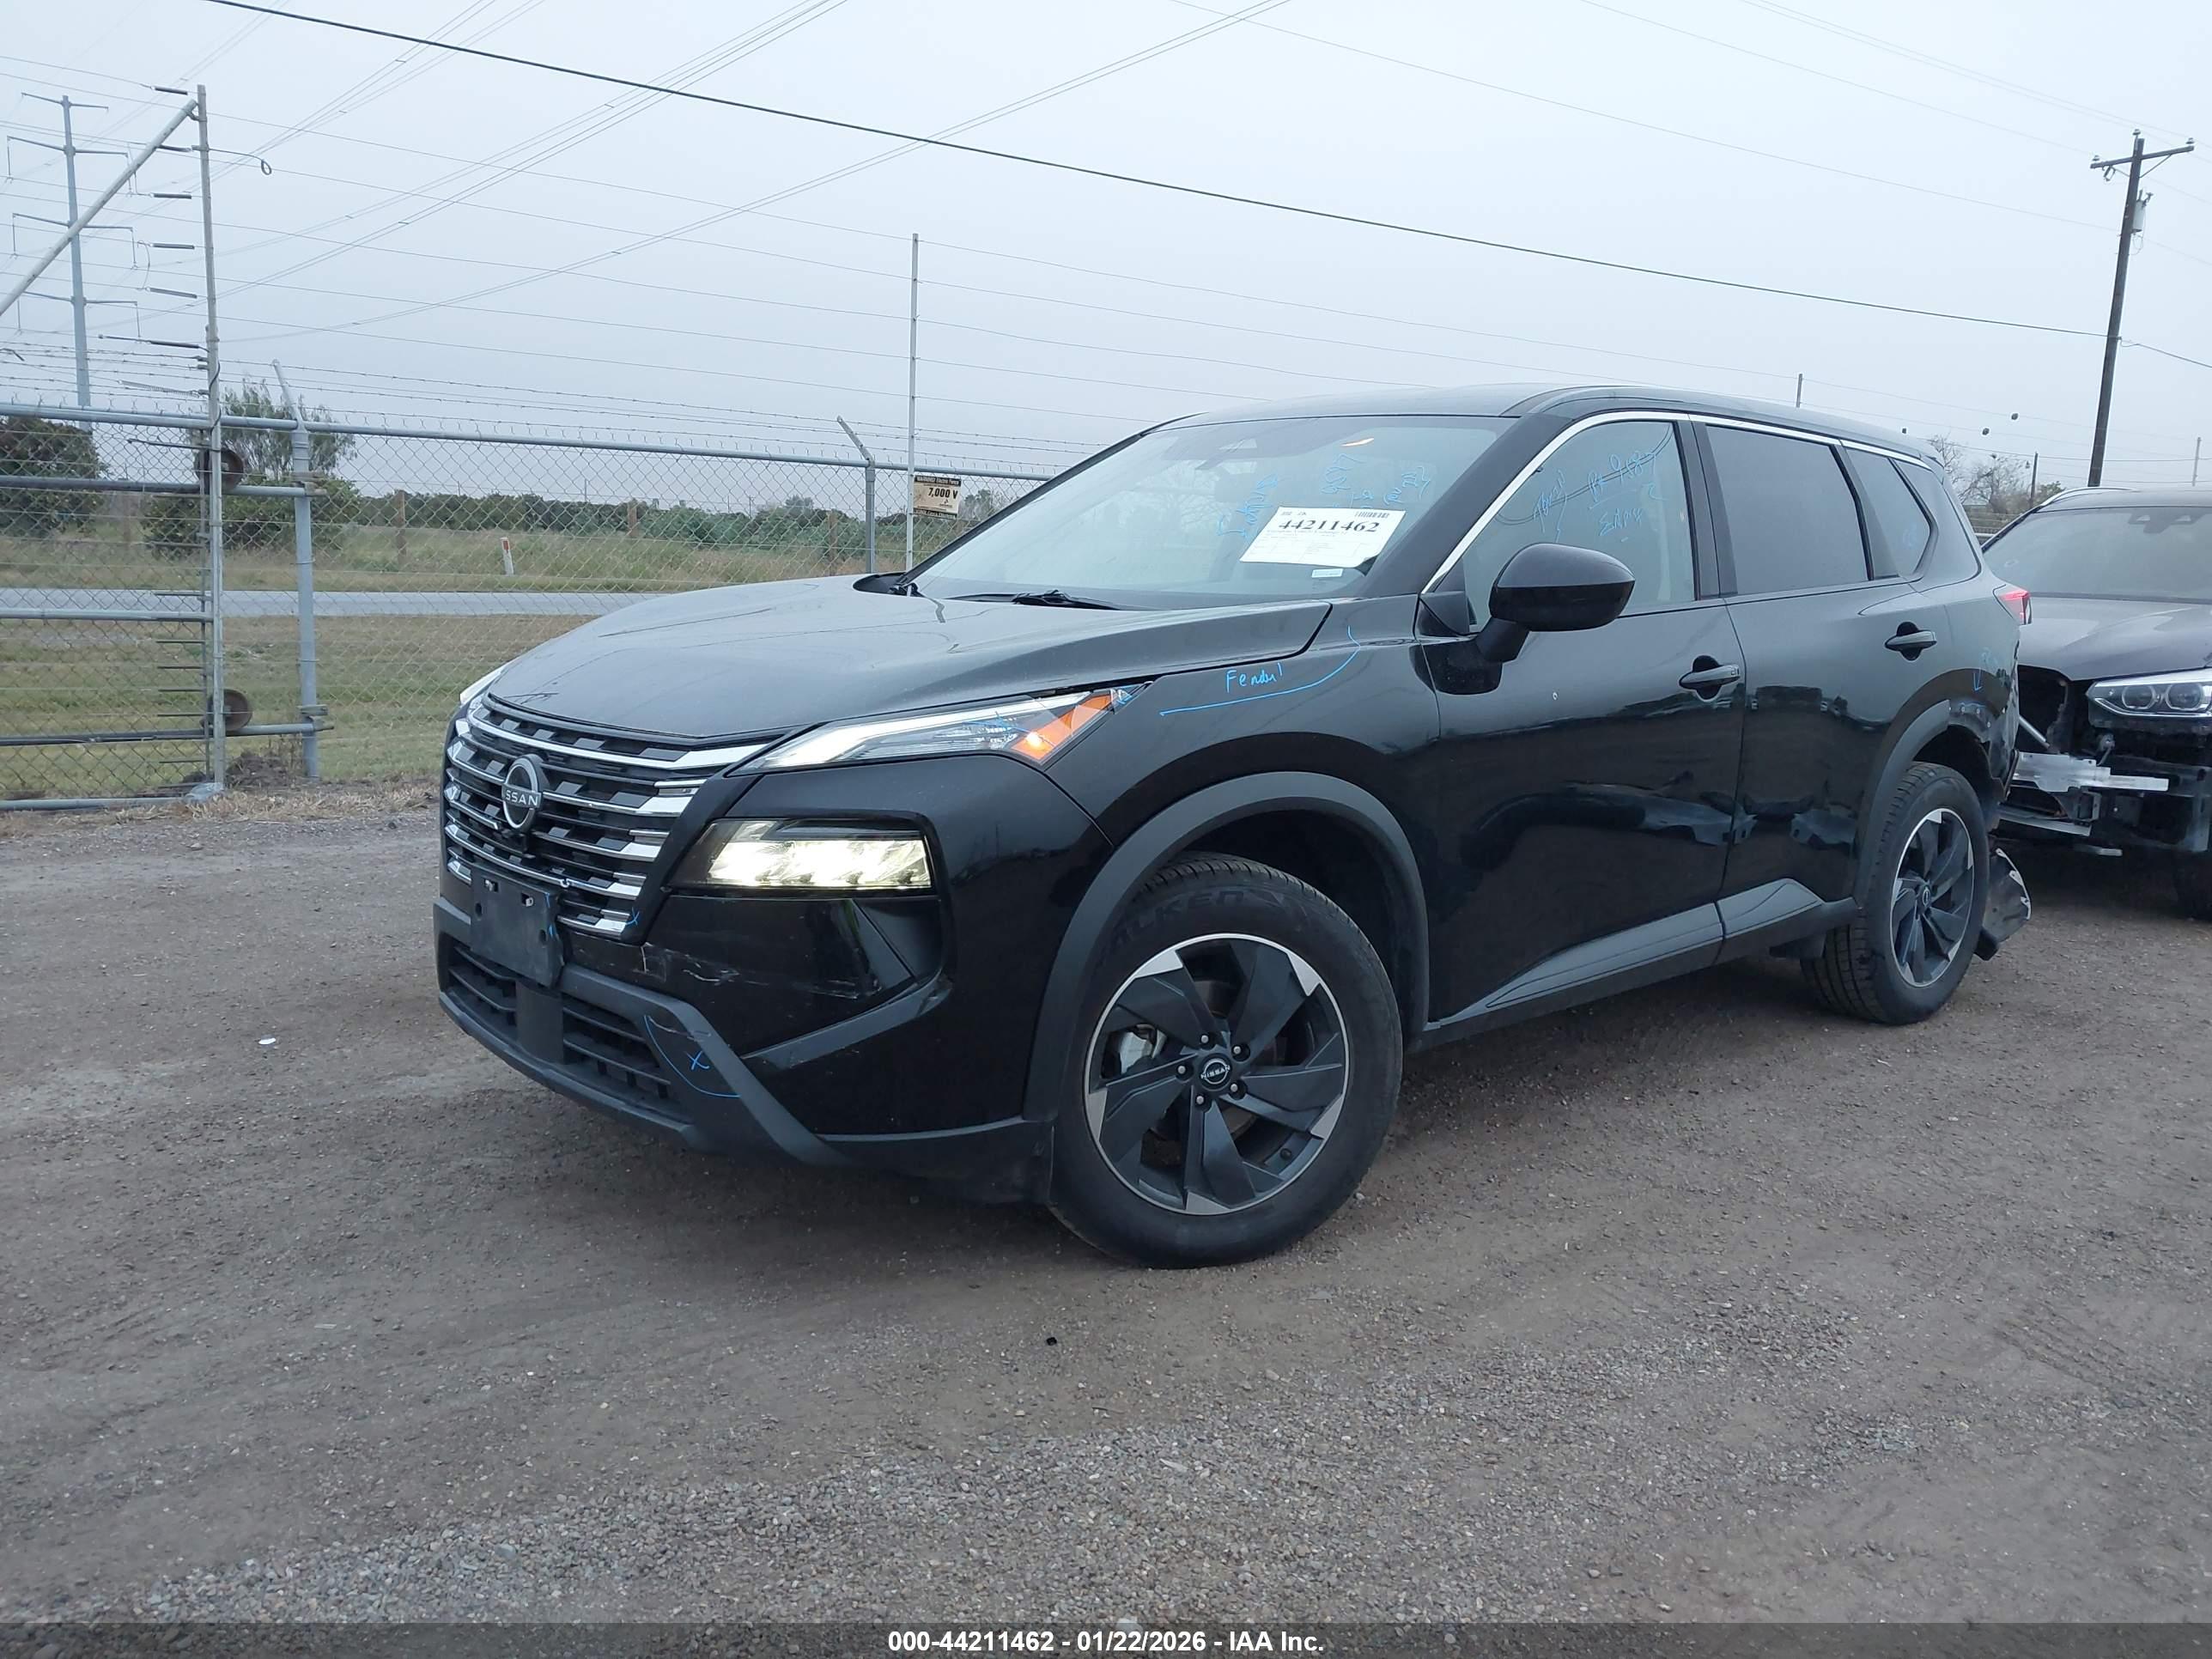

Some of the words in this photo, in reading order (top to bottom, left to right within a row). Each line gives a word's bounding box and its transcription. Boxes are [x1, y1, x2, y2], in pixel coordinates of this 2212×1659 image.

[927, 487, 951, 498] 7,000
[952, 489, 958, 500] V
[1278, 519, 1380, 532] 44211462
[505, 788, 538, 806] SSAN
[1109, 889, 1244, 949] ALKEN
[1200, 1064, 1231, 1079] NISSAN
